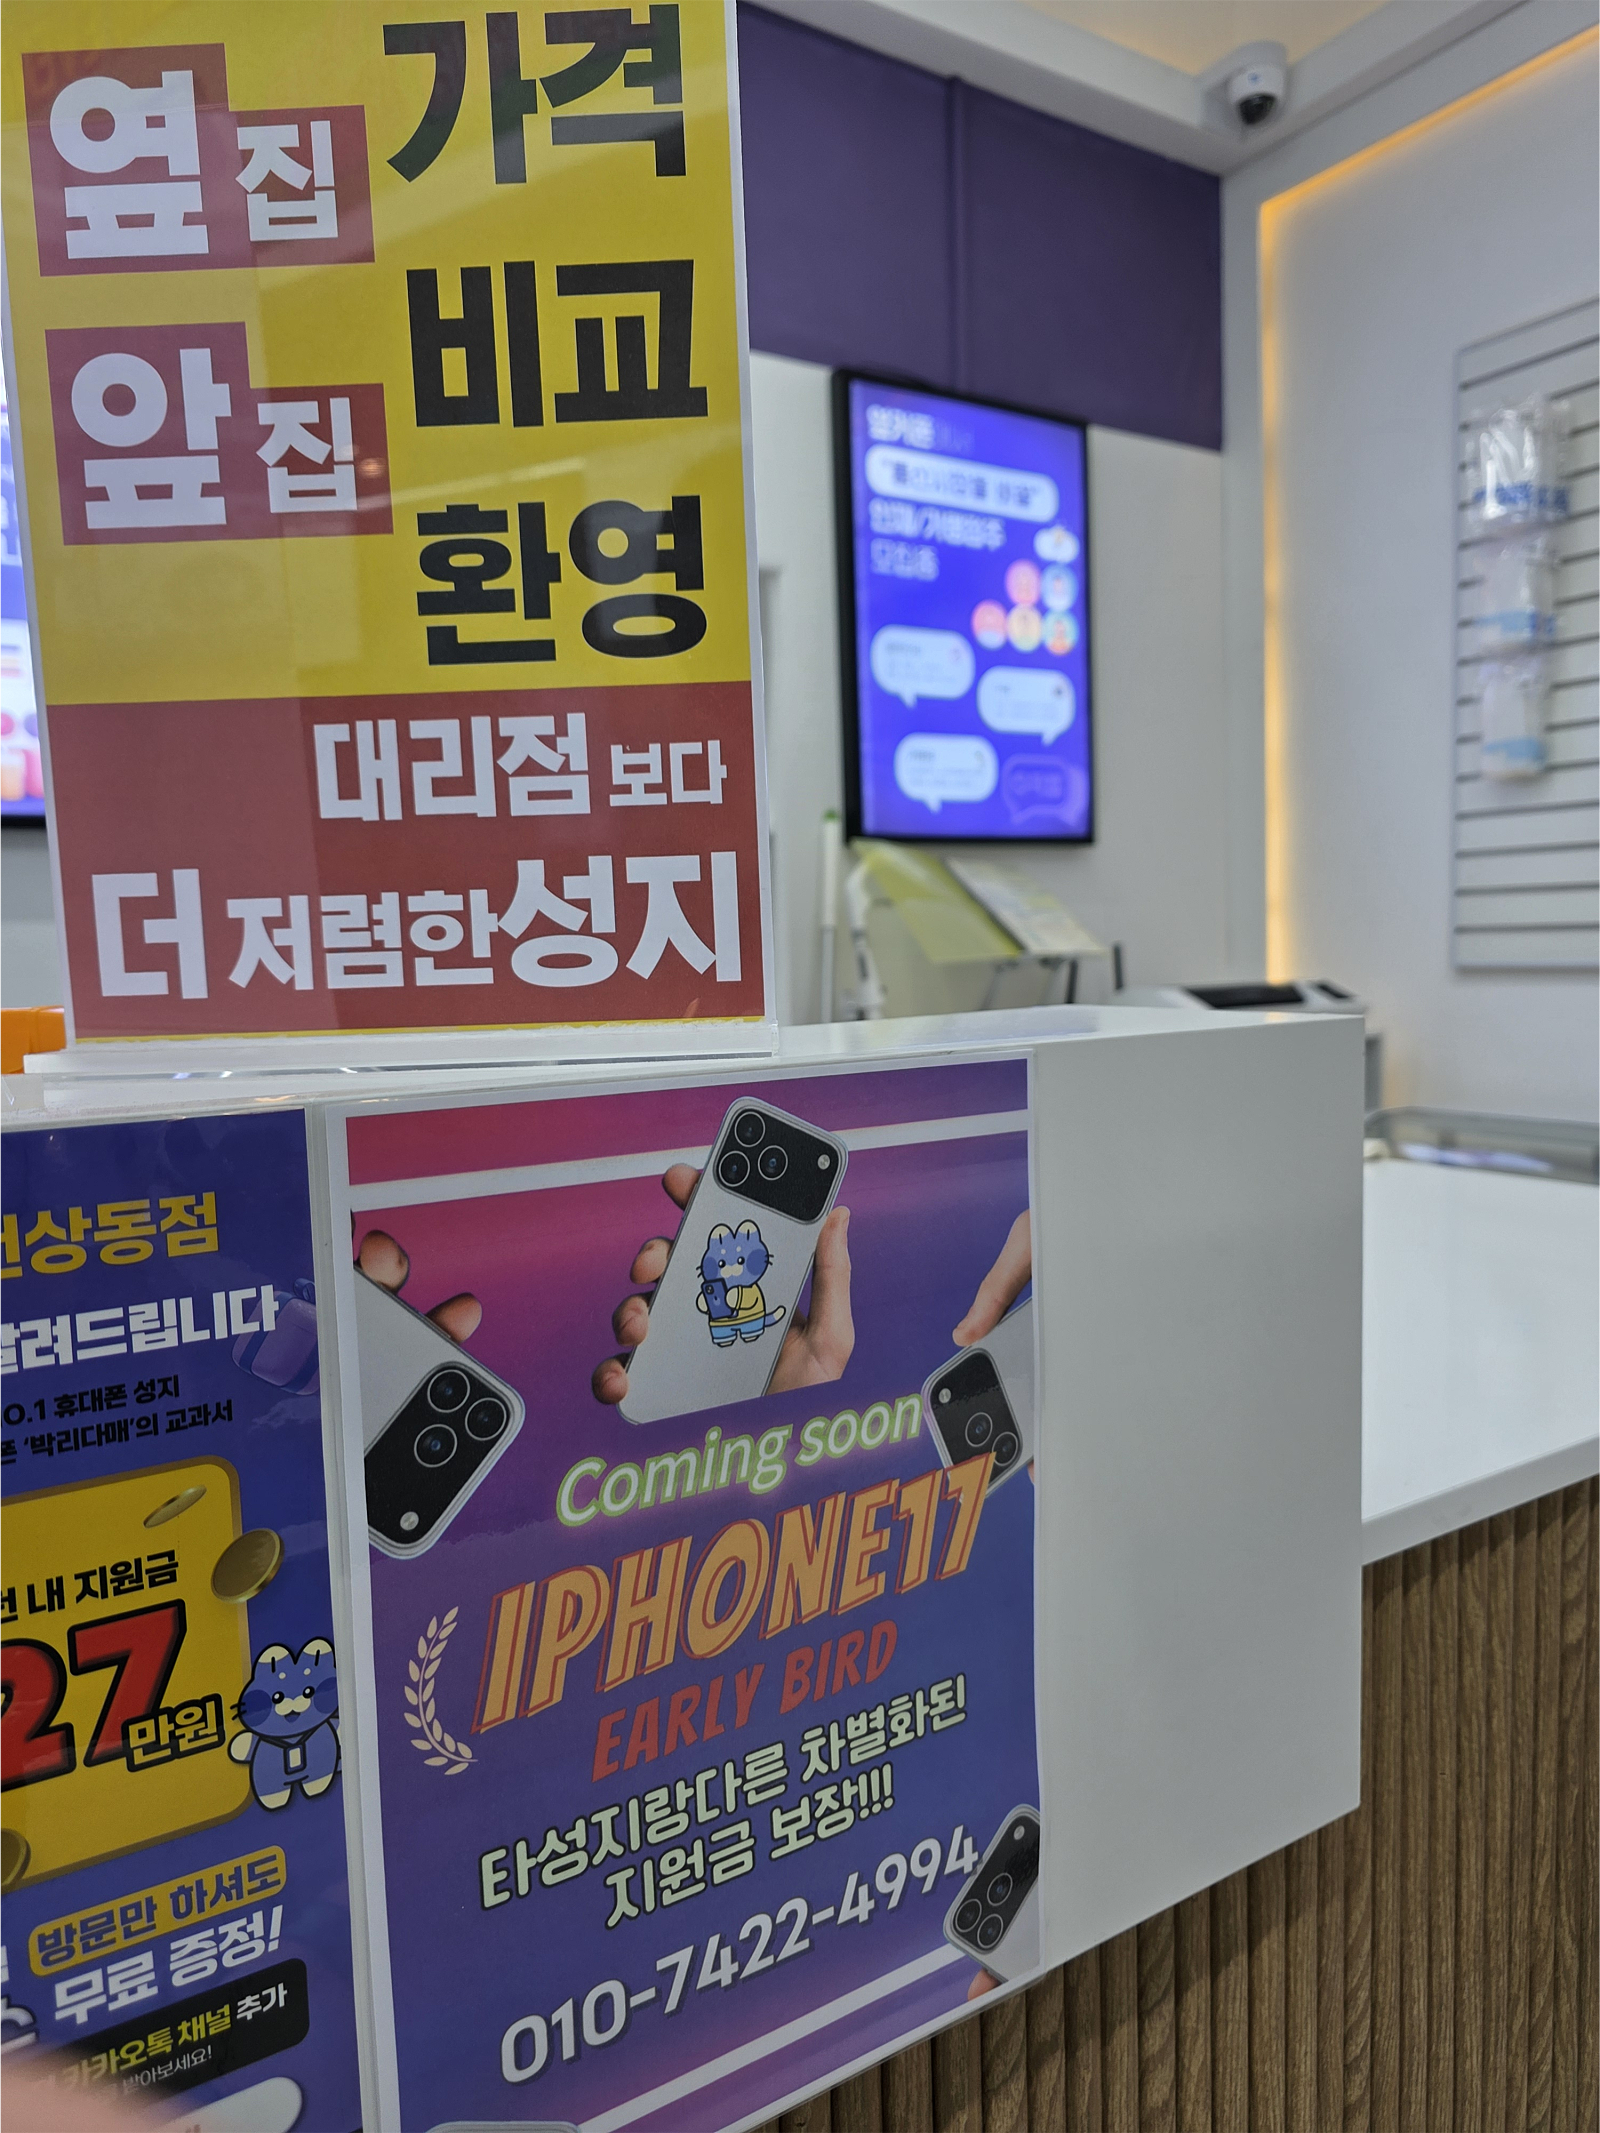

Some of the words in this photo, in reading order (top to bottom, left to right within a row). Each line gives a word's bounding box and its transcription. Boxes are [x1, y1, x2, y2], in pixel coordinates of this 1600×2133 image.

[382, 3, 687, 185] 가격
[406, 259, 709, 429] 비교
[416, 494, 708, 665] 환영
[313, 712, 591, 821] 대리점
[609, 739, 728, 807] 보다
[92, 868, 208, 999] 더
[53, 1384, 128, 1418] 휴대폰
[133, 1375, 180, 1403] 성지
[165, 1399, 234, 1434] 교과서
[557, 1424, 793, 1526] Coming
[799, 1393, 922, 1466] soon
[27, 1575, 65, 1614] 내
[74, 1550, 179, 1604] 지원금
[471, 1451, 996, 1735] IPHONE17
[592, 1664, 764, 1783] EARLY
[780, 1620, 898, 1715] BIRD
[480, 1743, 787, 1909] 타성지랑다른
[801, 1674, 967, 1783] 차별화된
[606, 1823, 756, 1930] 지원금
[770, 1764, 895, 1861] 보장!!!
[37, 1895, 157, 1968] 방문만
[169, 1854, 281, 1920] 하셔도
[54, 1950, 158, 2025] 무료
[169, 1904, 283, 1987] 증정!
[500, 1824, 980, 2085] 010-7422-4994
[178, 2004, 231, 2046] 채널
[236, 1983, 288, 2020] 추가
